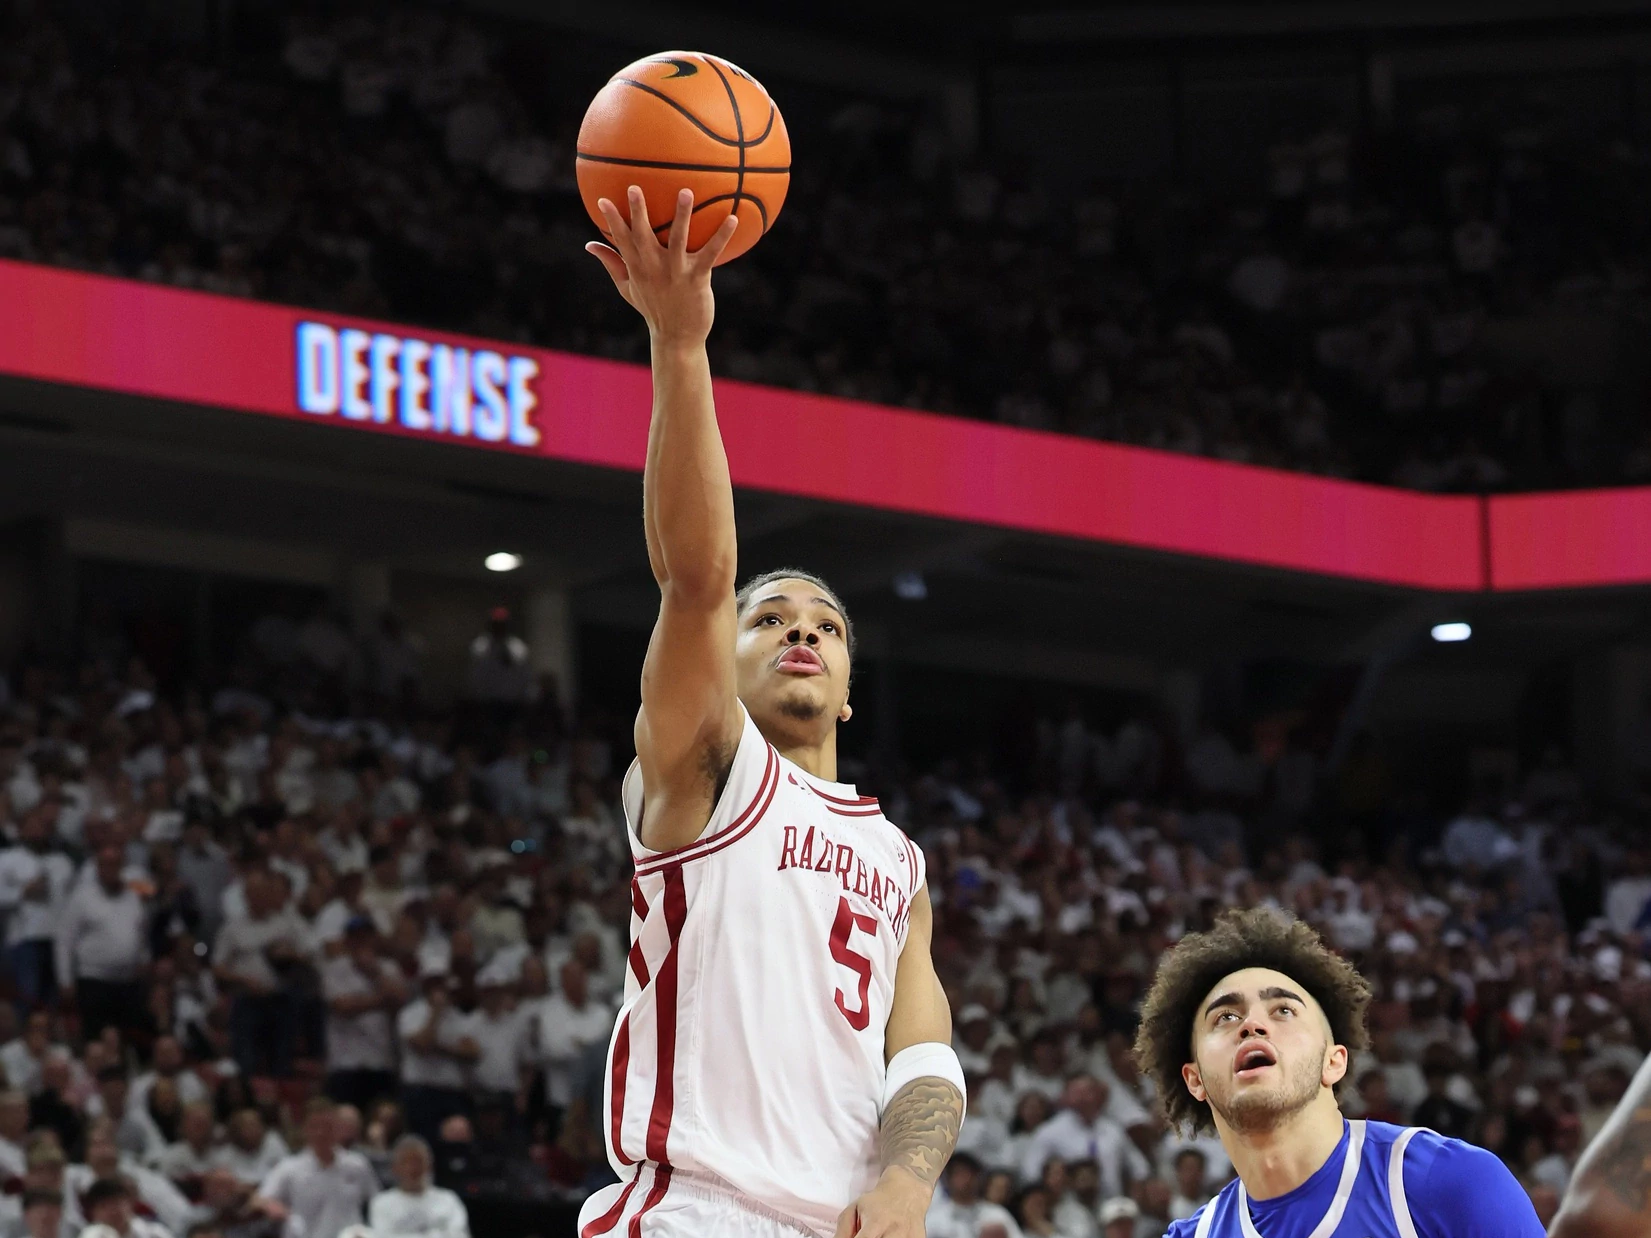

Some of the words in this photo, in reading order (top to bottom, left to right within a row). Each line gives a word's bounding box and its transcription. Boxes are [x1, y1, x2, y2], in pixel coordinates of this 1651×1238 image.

[296, 320, 541, 447] DEFENSE
[777, 825, 911, 946] RAZRBACK
[828, 895, 878, 1032] 5
